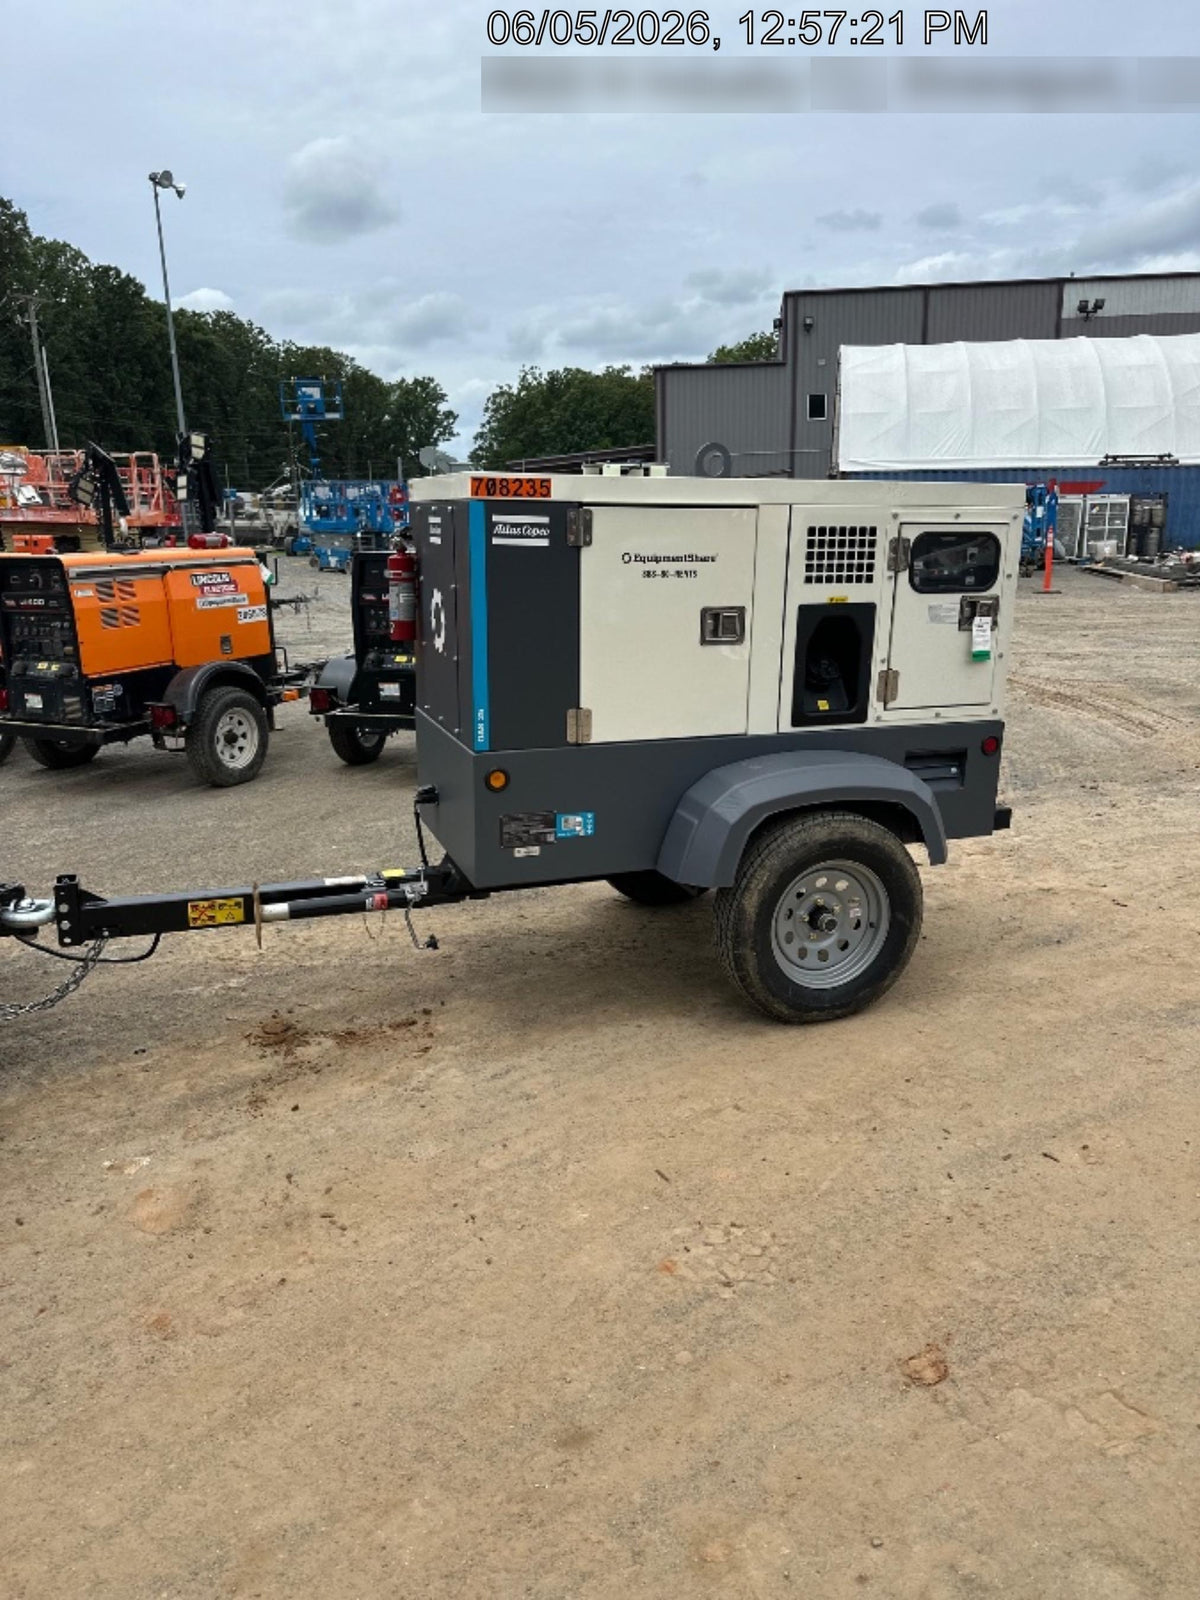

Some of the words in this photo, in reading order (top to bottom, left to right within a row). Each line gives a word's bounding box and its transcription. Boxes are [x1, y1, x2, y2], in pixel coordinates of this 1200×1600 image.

[472, 477, 550, 496] 708235
[493, 524, 521, 535] Atlas
[633, 553, 717, 564] EquipmentShare
